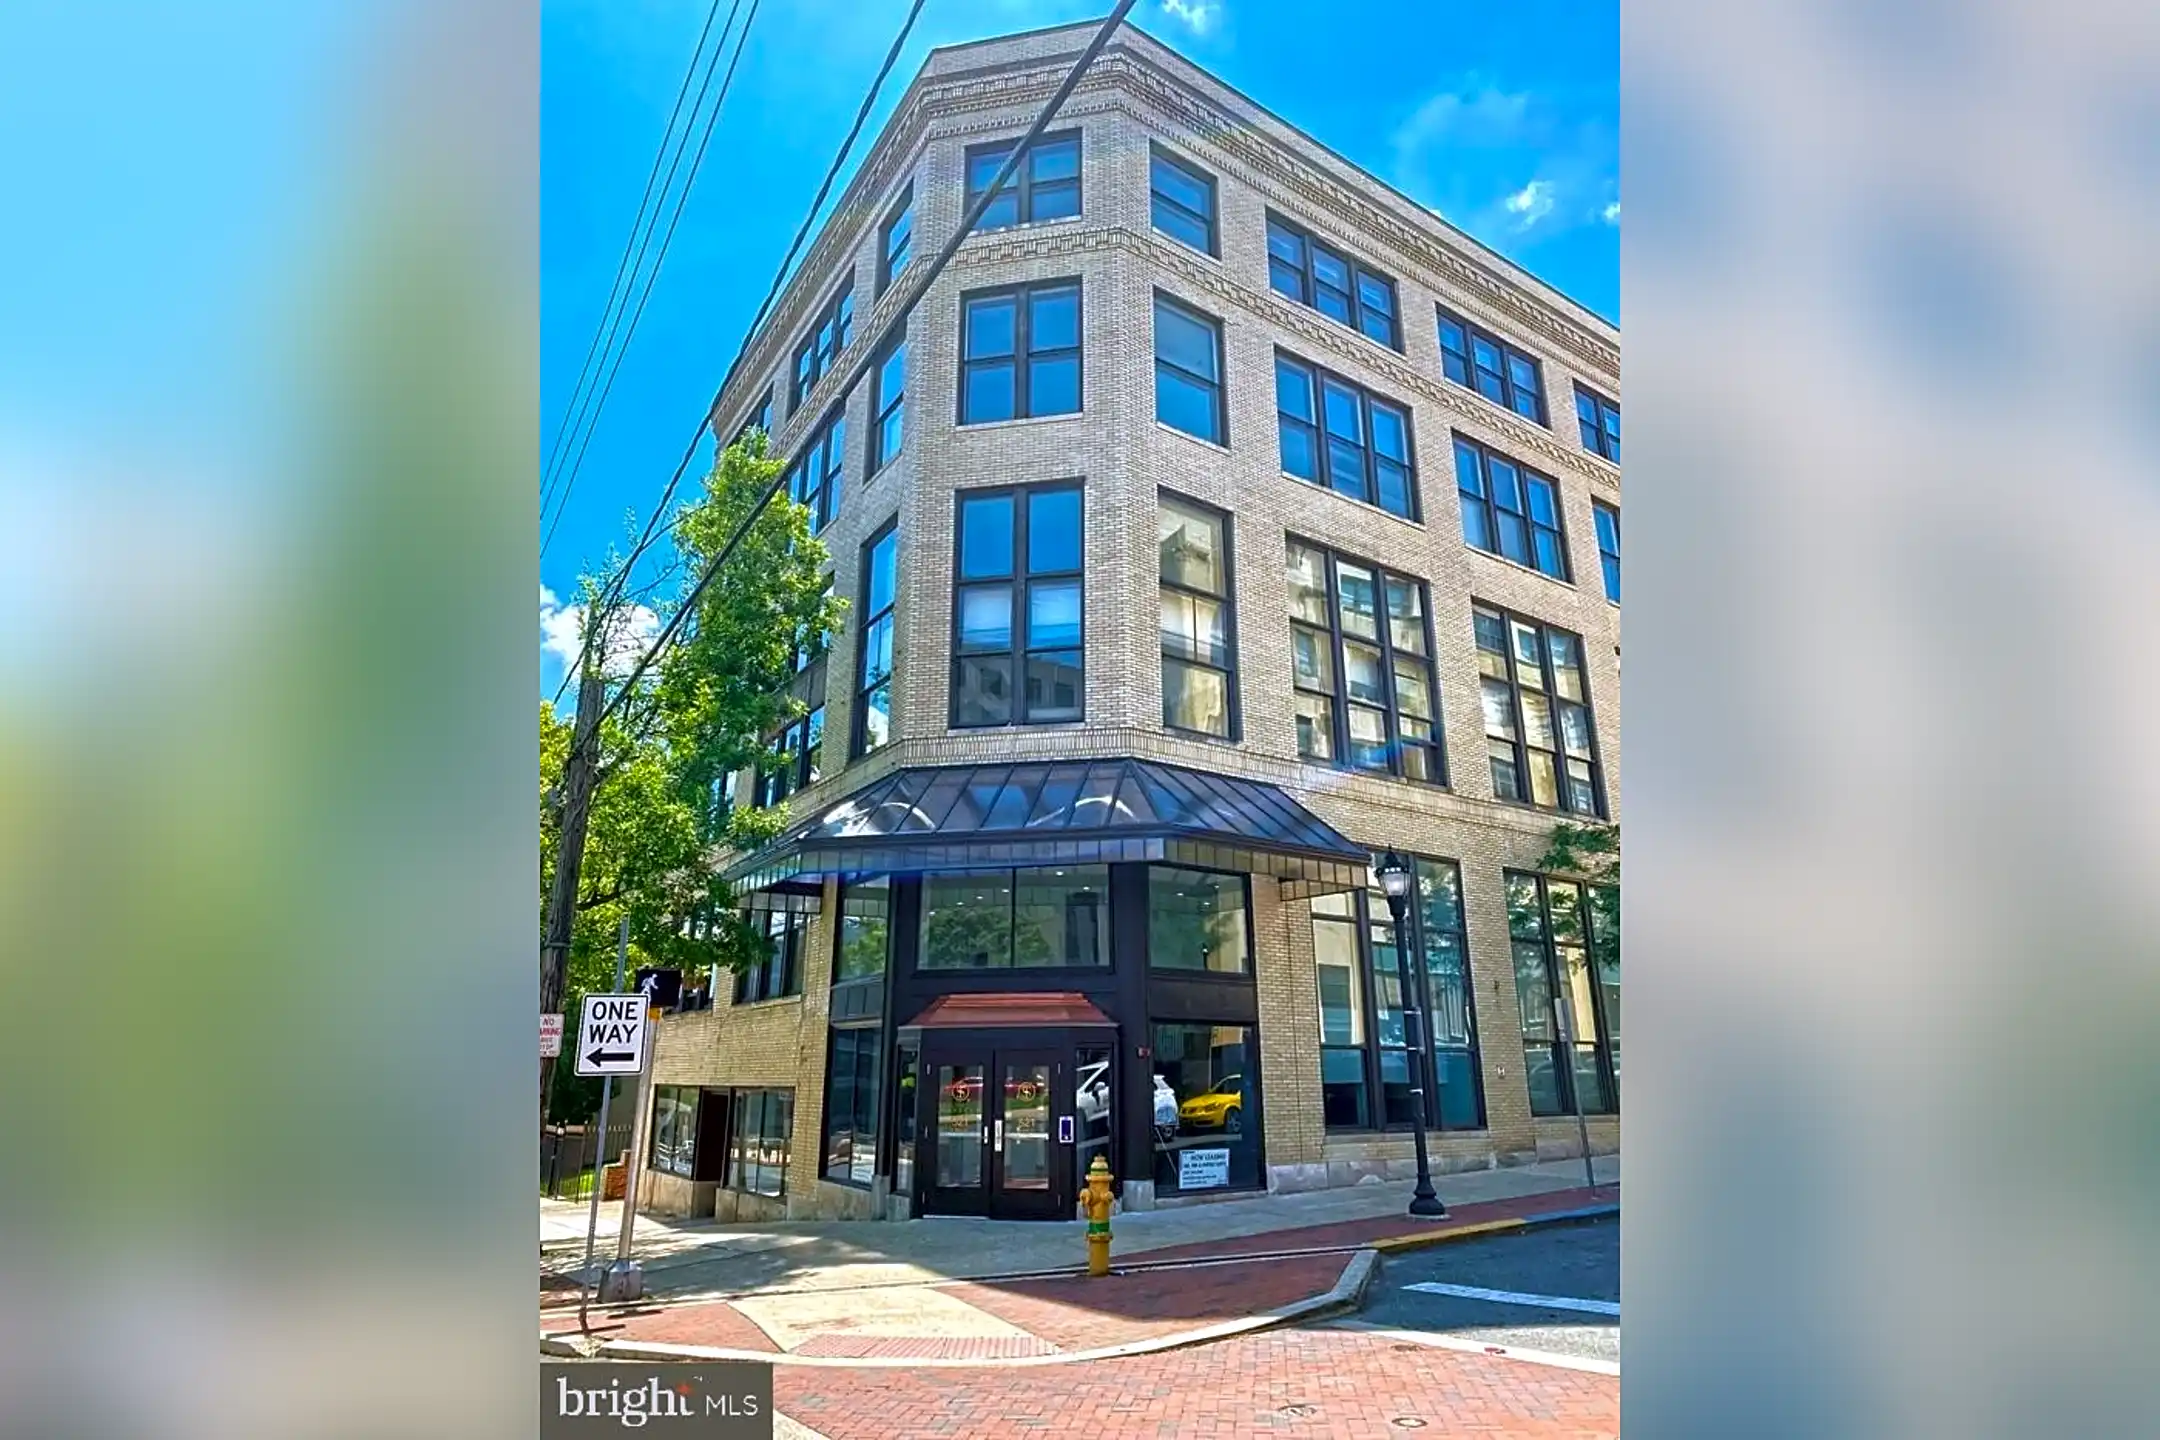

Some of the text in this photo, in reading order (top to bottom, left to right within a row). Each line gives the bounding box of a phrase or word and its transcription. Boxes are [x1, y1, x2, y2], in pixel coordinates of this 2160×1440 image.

[592, 1001, 638, 1020] ONE
[543, 1018, 554, 1026] NO
[589, 1024, 638, 1044] WAY
